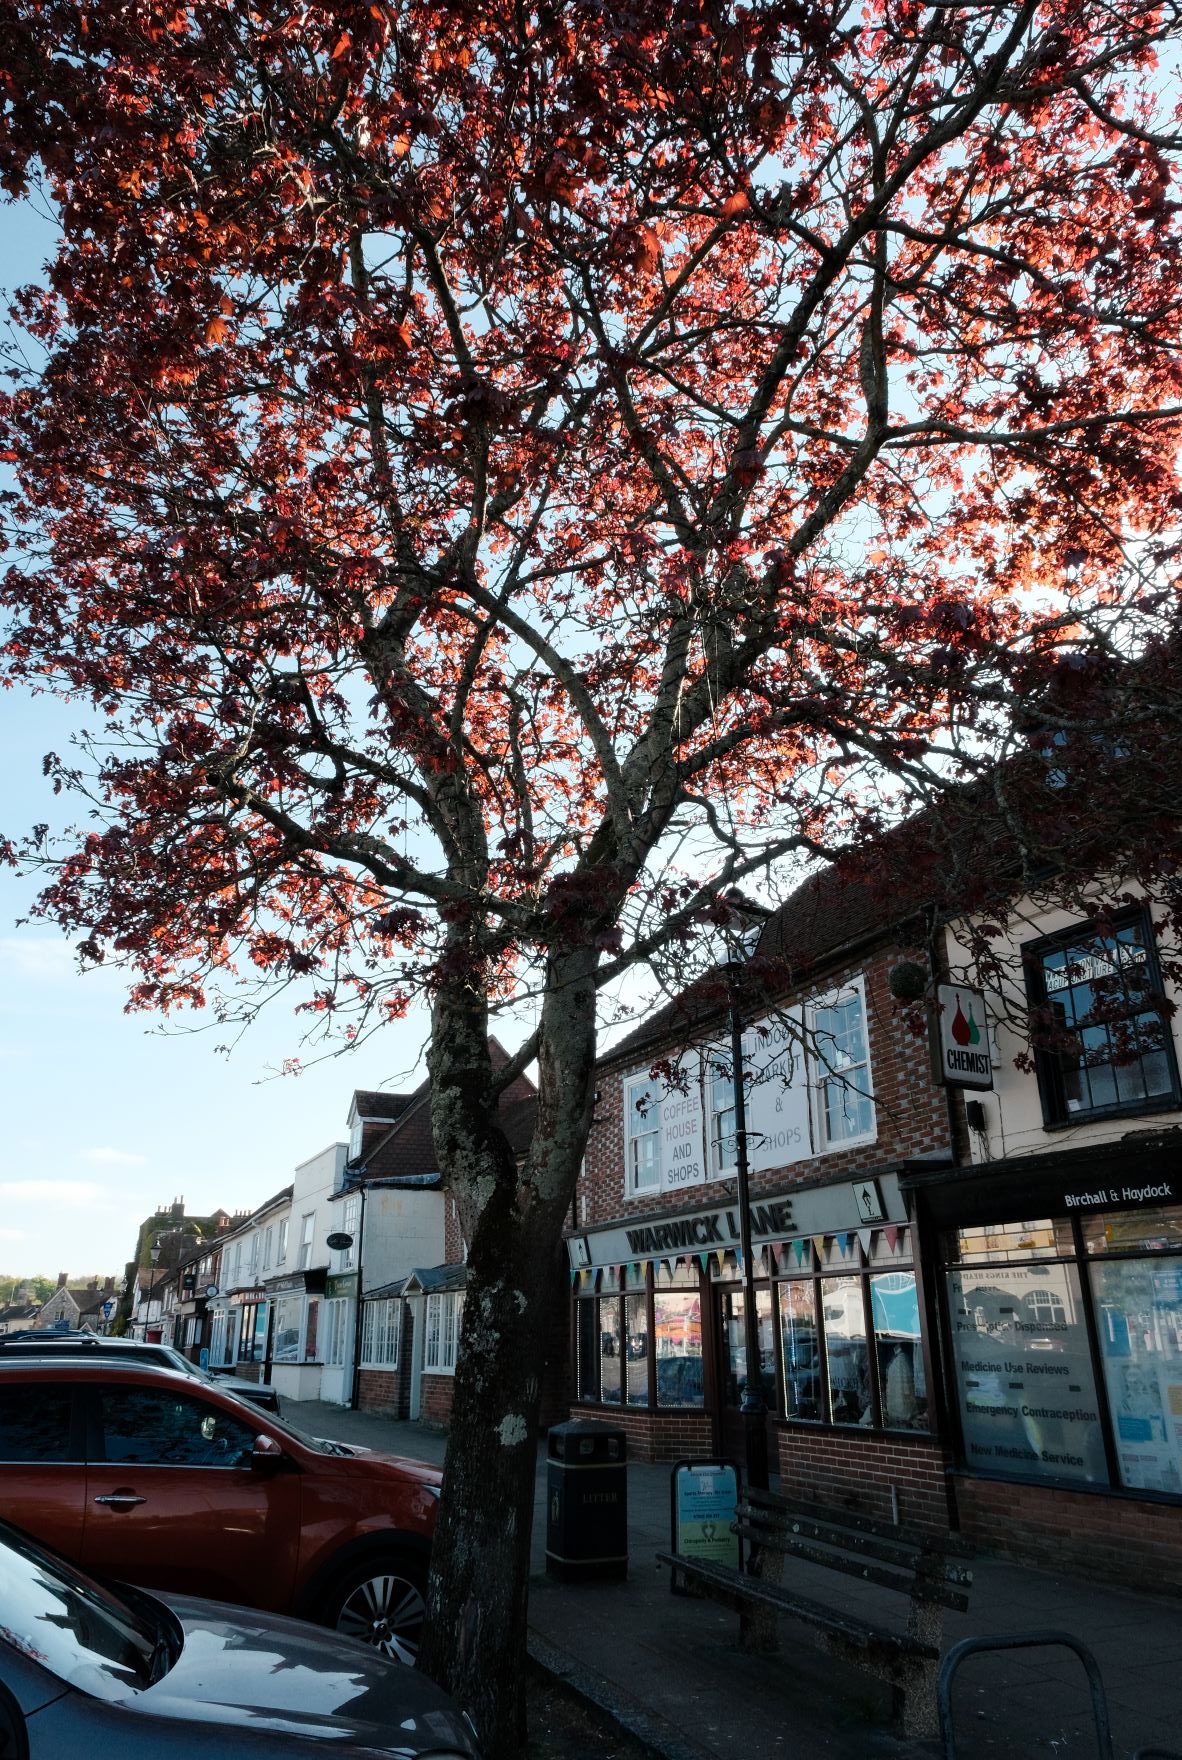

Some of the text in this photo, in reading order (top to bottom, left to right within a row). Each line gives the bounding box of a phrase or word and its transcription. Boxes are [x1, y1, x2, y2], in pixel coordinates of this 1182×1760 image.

[947, 1049, 989, 1075] CHEMIST
[663, 1096, 700, 1121] COFFEE
[775, 1097, 783, 1113] &
[666, 1119, 697, 1142] HOUSE
[762, 1127, 802, 1152] SHOPS
[672, 1142, 692, 1161] AND
[667, 1163, 699, 1184] SHOPS
[1064, 1182, 1174, 1207] Birchall & Haydock
[625, 1214, 725, 1254] WARWICK
[726, 1200, 798, 1239] LANE
[1014, 1320, 1068, 1334] Dispensed
[961, 1361, 1070, 1375] Medicine Use Reviews
[966, 1402, 1097, 1423] Emergency Contraception
[971, 1443, 1084, 1466] New Medicine Service
